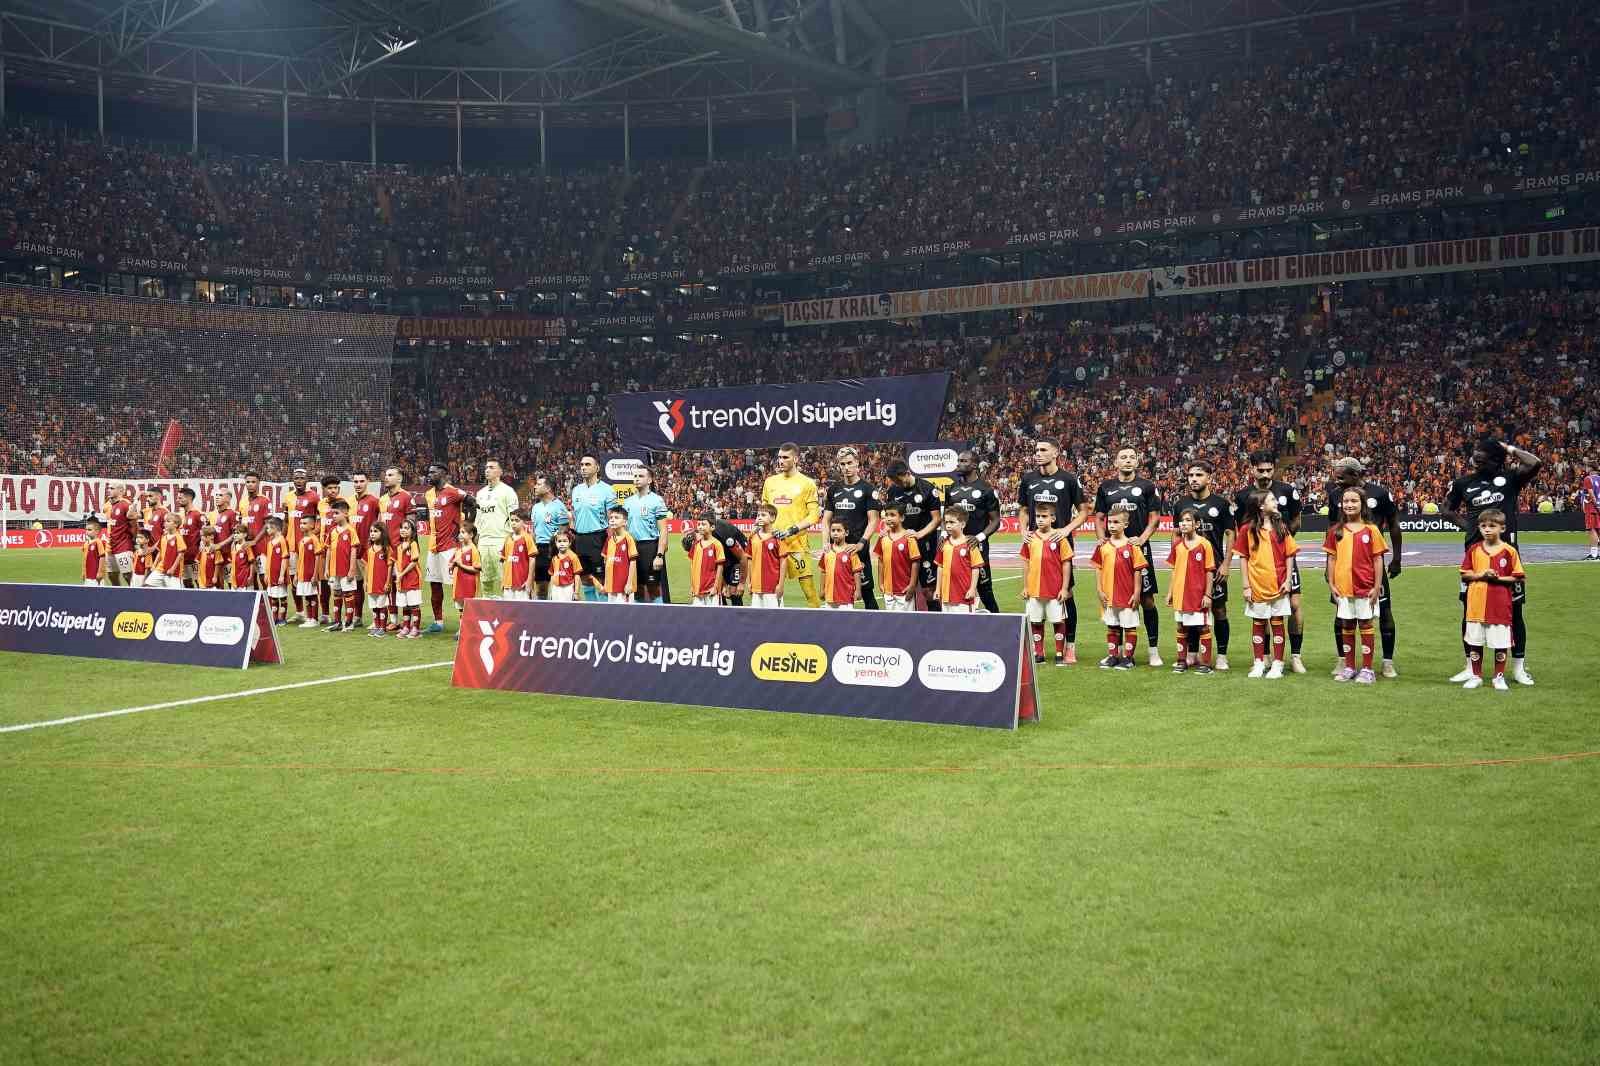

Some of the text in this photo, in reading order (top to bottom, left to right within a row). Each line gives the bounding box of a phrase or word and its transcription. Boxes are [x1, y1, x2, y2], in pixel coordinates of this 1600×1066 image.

[1526, 174, 1570, 189] RAMS
[1379, 185, 1465, 205] RAMS PARK
[1249, 201, 1325, 220] RAMS PARK
[1127, 215, 1197, 233] RAMS PARK
[1015, 228, 1080, 244] RAMS PARK
[23, 242, 85, 260] RAMS PARK
[911, 240, 971, 256] RAMS PARK
[126, 256, 188, 273] RAMS PARK
[814, 251, 872, 265] RAMS PARK
[232, 266, 292, 281] RAMS PARK
[333, 273, 393, 285] RAMS PARK
[536, 275, 592, 286] RAMS PARK
[839, 296, 879, 319] KRAL
[692, 310, 748, 321] RAMS PARK
[690, 398, 897, 431] trendyol süperLig
[916, 451, 952, 463] trendyol
[0, 477, 37, 515] AÇ
[1400, 519, 1443, 532] endyol
[795, 559, 806, 570] 30
[51, 607, 106, 636] süperLig
[518, 629, 634, 668] trendyol
[634, 640, 736, 677] süperLig
[846, 652, 902, 667] trendyol
[854, 667, 890, 679] yemek
[927, 664, 982, 676] Türk Telekom
